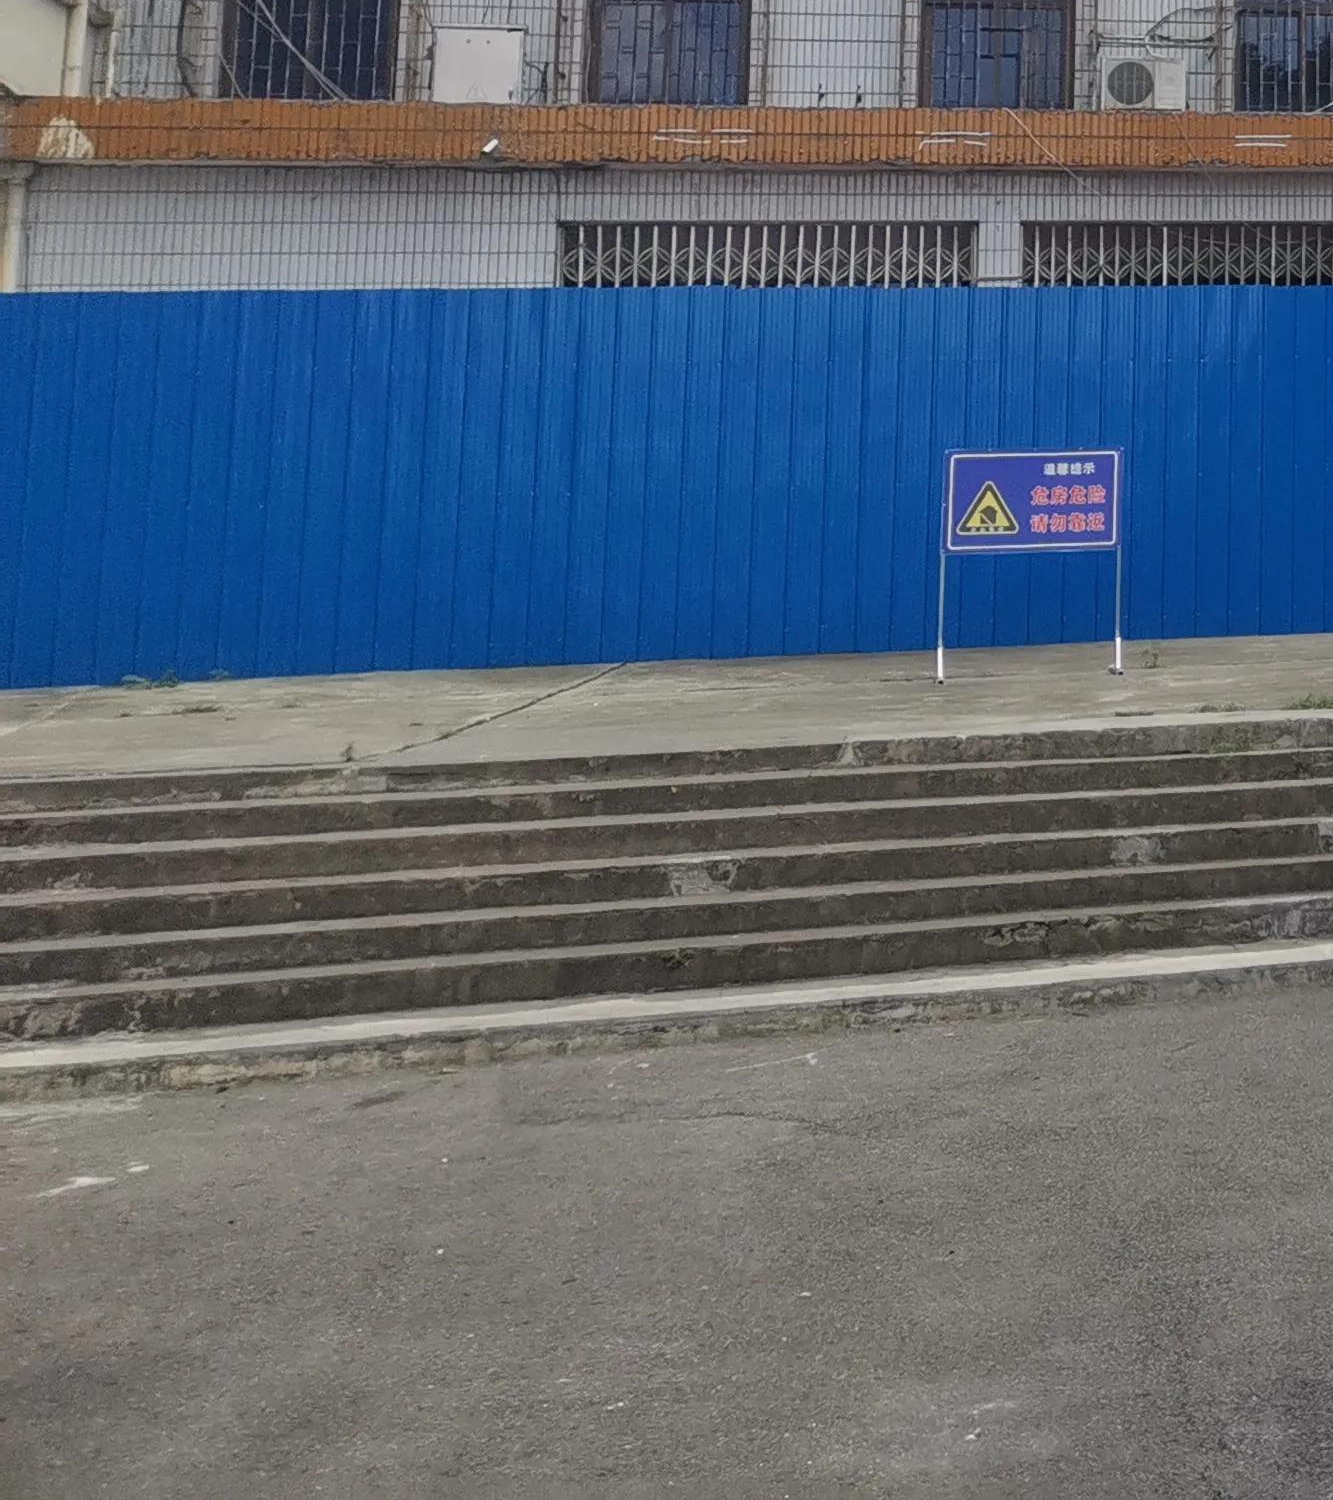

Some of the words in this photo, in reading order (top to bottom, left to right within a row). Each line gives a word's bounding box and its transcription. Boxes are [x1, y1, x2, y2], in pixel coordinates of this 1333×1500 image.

[1031, 485, 1106, 505] 危房危险
[1031, 512, 1105, 533] 请勿靠近
